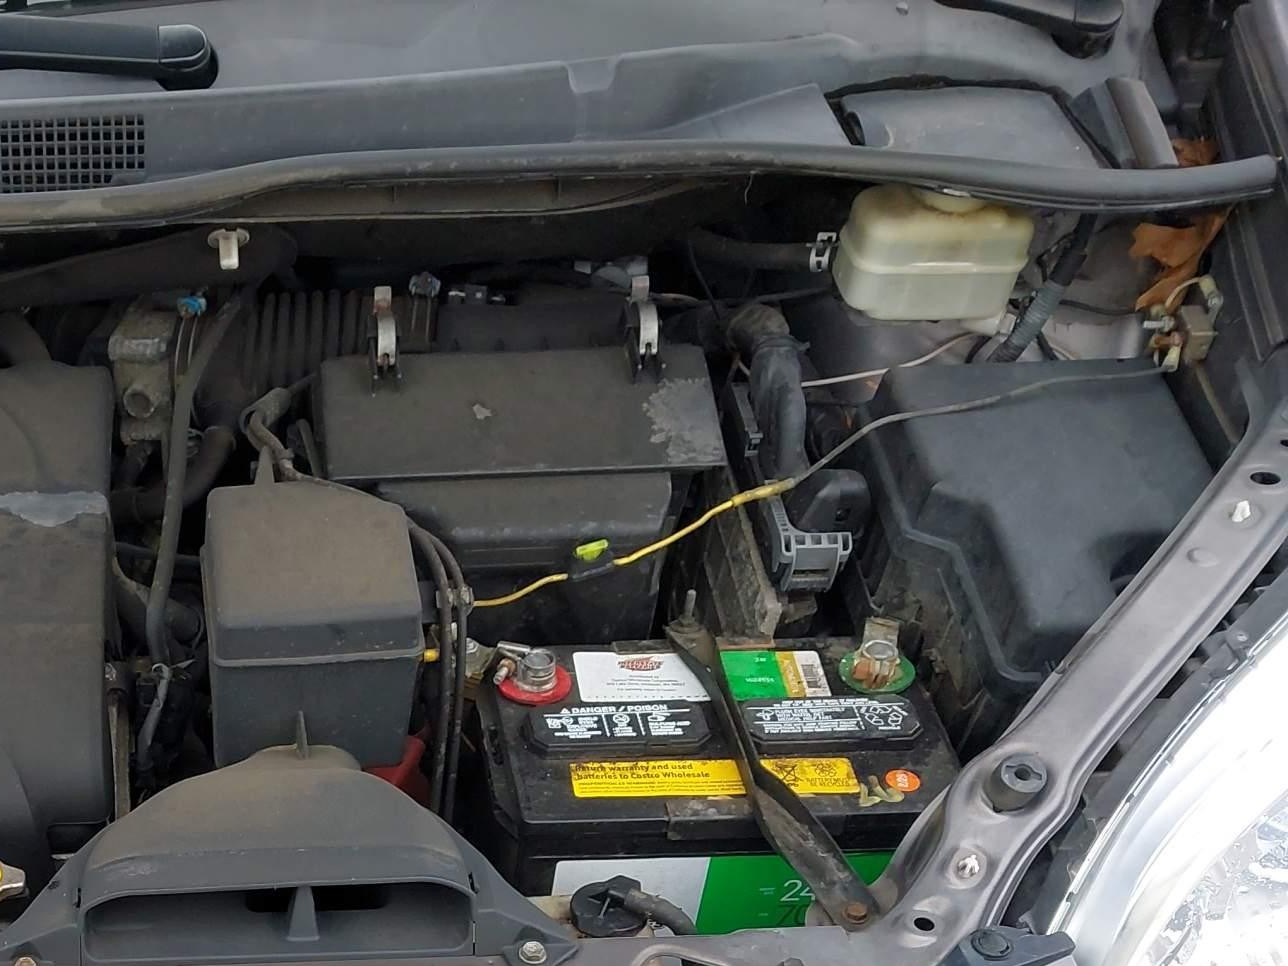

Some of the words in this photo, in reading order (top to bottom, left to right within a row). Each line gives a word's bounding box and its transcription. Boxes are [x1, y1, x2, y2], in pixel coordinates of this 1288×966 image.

[571, 705, 616, 714] DANGER
[627, 703, 668, 712] POISON
[609, 764, 649, 773] warranty
[652, 763, 669, 771] and
[671, 762, 693, 770] used
[663, 771, 710, 779] Wholesale
